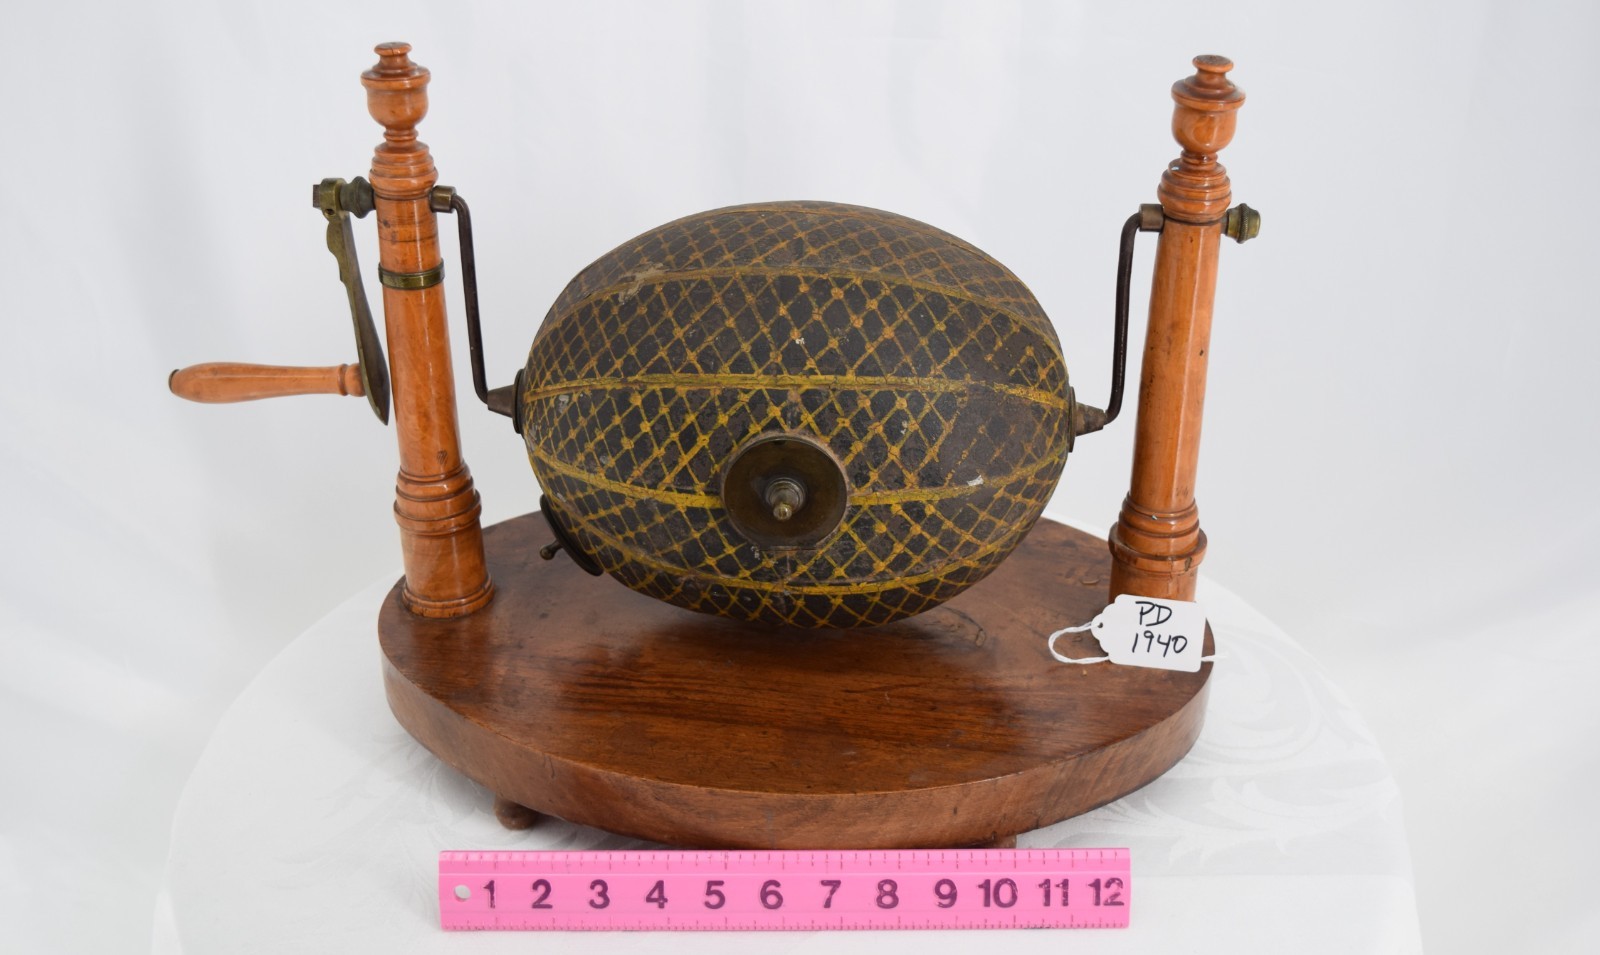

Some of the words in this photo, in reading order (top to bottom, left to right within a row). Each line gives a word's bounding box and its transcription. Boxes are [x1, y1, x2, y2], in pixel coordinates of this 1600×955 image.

[1135, 601, 1172, 627] PD
[1131, 630, 1188, 658] 1940
[483, 880, 496, 909] 1
[531, 879, 553, 909] 2
[588, 879, 610, 909] 3
[645, 880, 668, 909] 4
[704, 880, 726, 909] 5
[760, 880, 784, 909] 6
[820, 880, 842, 909] 7
[876, 879, 899, 909] 8
[934, 878, 958, 909] 9
[977, 878, 1018, 908] 10
[1038, 878, 1069, 907] 11
[1087, 878, 1125, 907] 12
